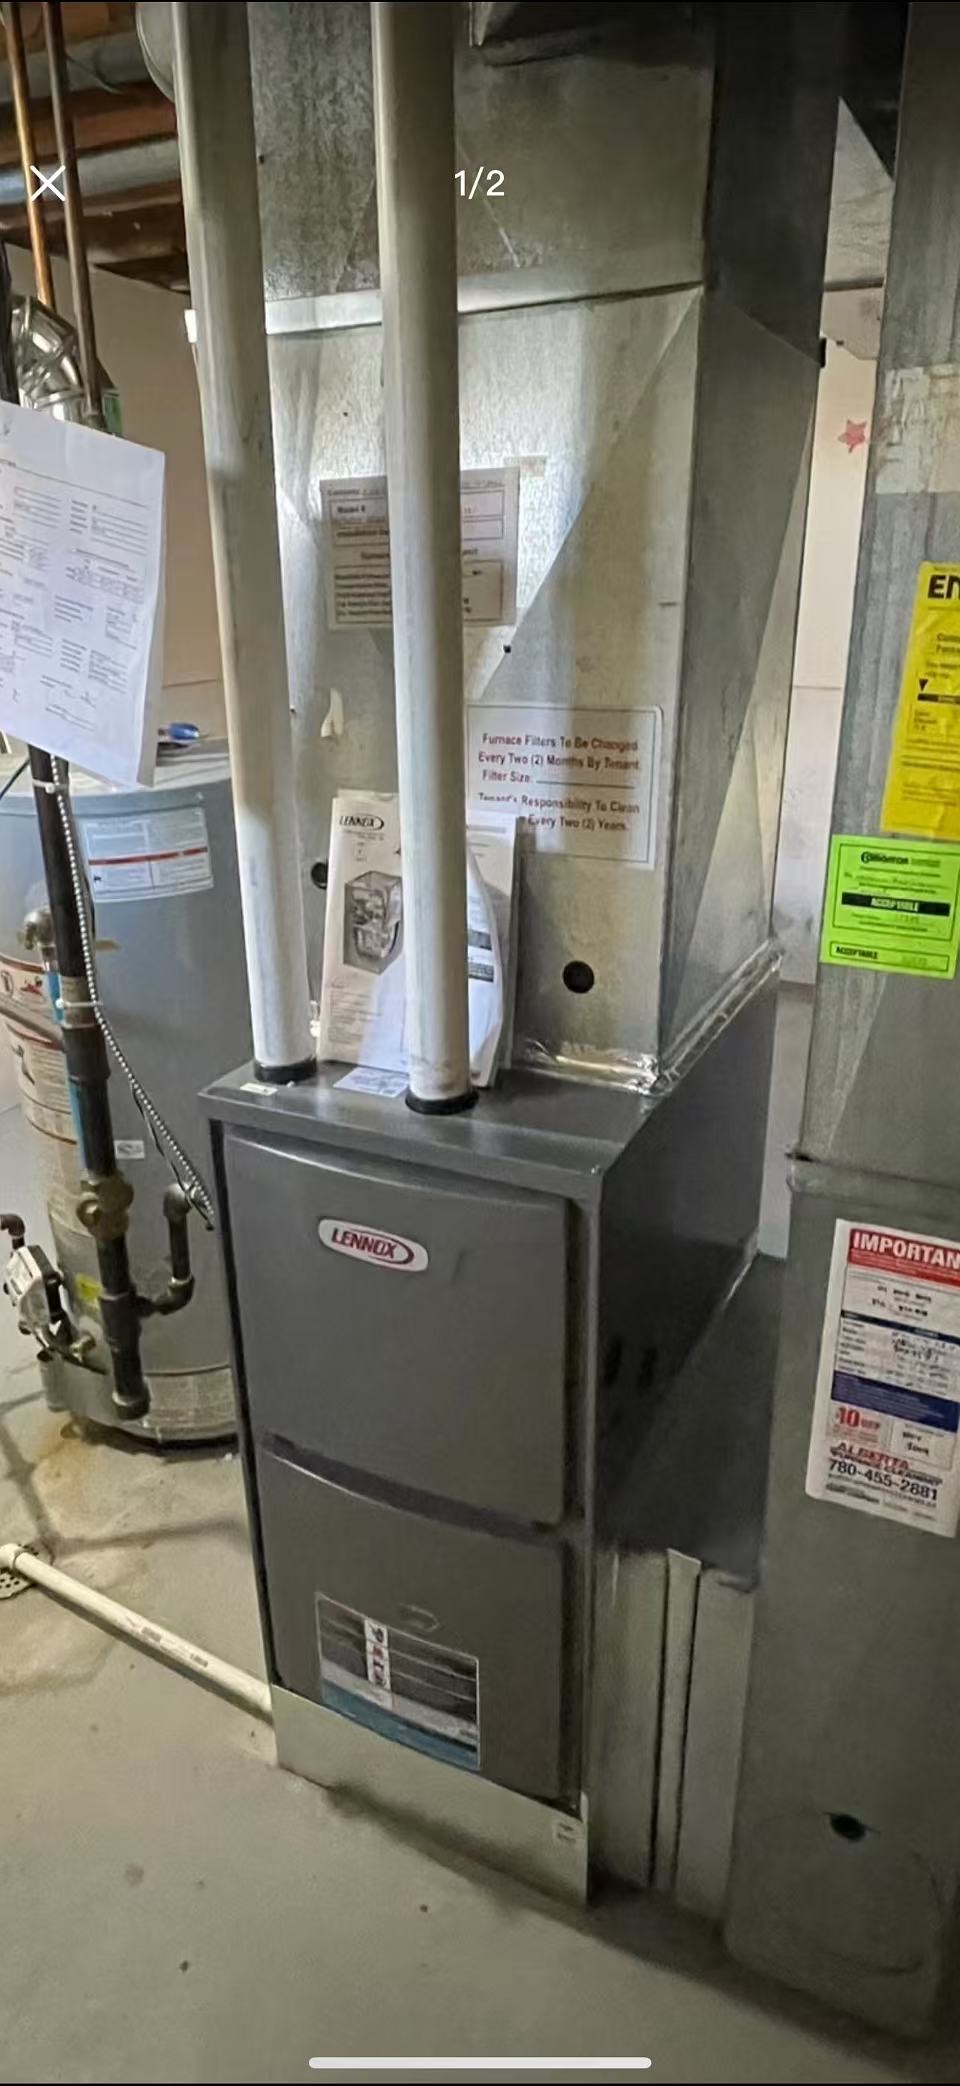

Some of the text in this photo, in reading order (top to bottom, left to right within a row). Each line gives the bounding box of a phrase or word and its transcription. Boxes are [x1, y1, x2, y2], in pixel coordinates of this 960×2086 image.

[482, 732, 639, 753] Furnace Filters To Be Changed
[478, 751, 639, 772] Every Two (2) Months By Tenant
[482, 769, 508, 782] Filter
[521, 795, 592, 813] Responsibility
[596, 799, 608, 813] To
[610, 800, 640, 814] Clean
[528, 813, 556, 829] Every
[560, 816, 580, 829] Two
[582, 817, 596, 831] (2)
[836, 945, 879, 960] ACCEPTABLE
[331, 1227, 398, 1260] LENNOX
[839, 1442, 909, 1470] ALBERTA
[828, 1459, 938, 1501] 780-455-2881
